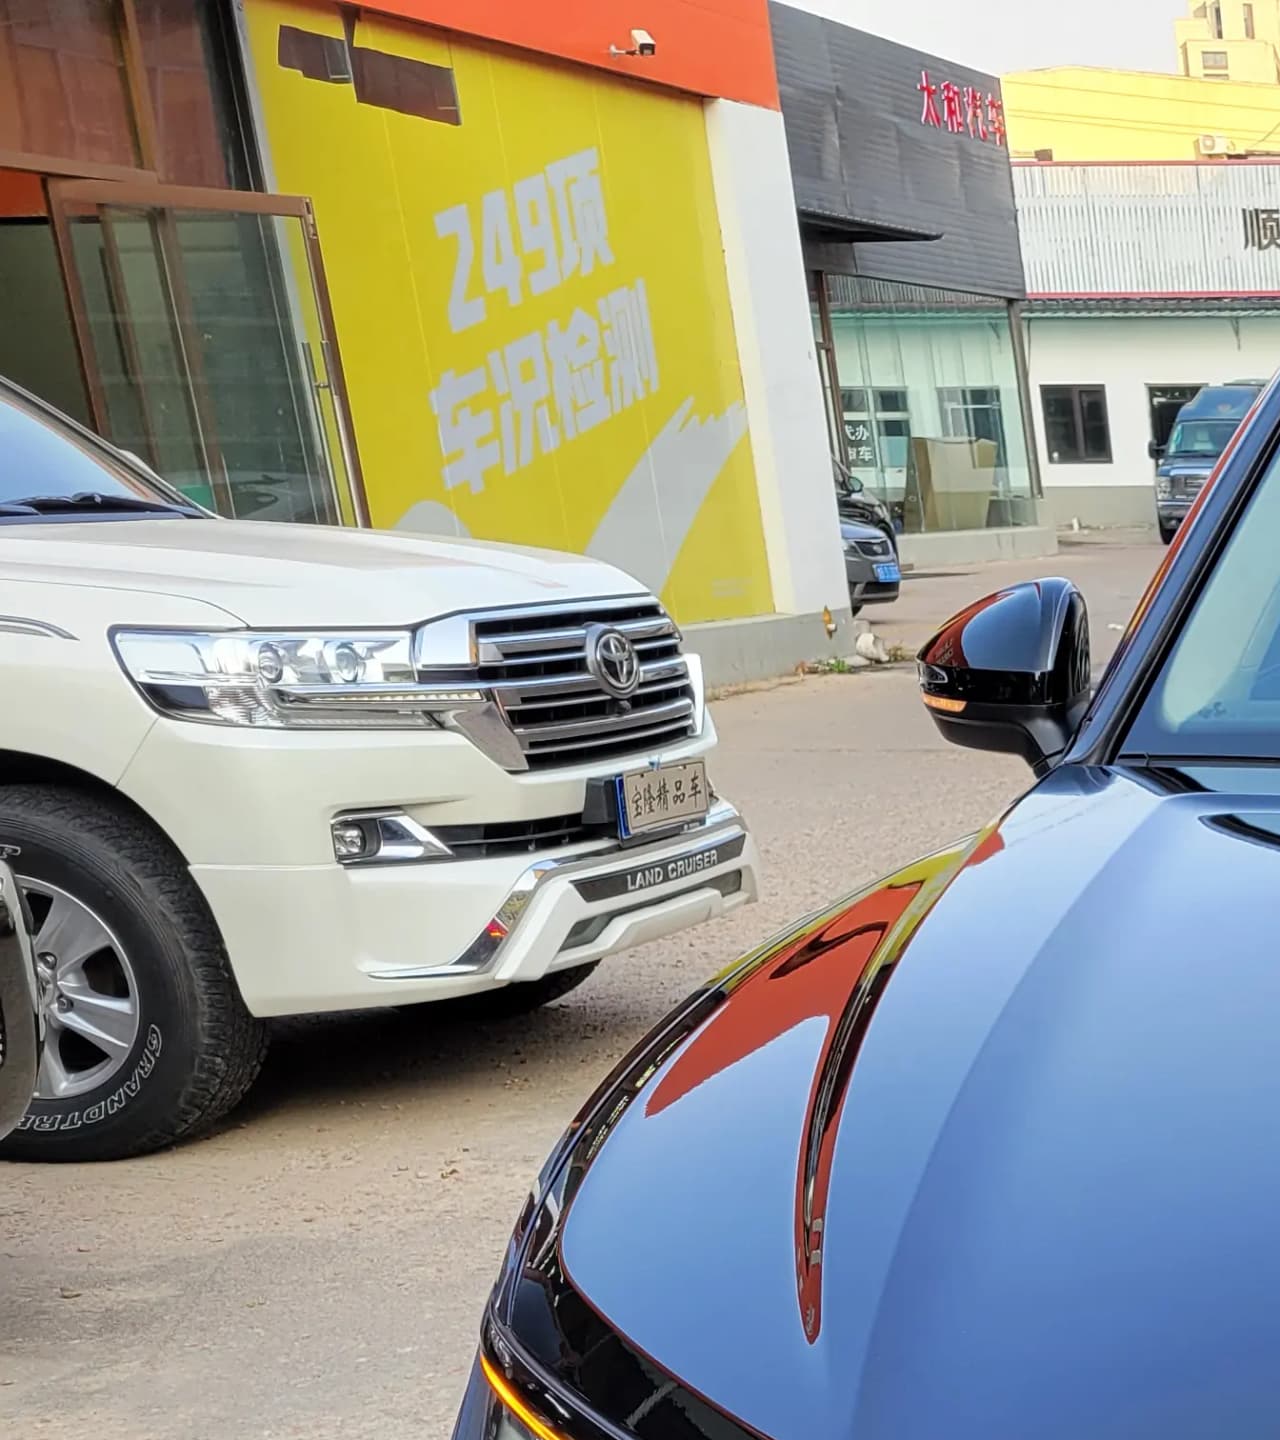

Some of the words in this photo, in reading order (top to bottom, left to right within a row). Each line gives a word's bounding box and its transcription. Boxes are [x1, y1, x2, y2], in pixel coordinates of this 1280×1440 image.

[434, 146, 615, 334] 249项
[429, 276, 660, 495] 车况检测
[631, 770, 703, 819] 宝隆精品车
[627, 868, 664, 891] LAND
[667, 849, 719, 880] CRUISER
